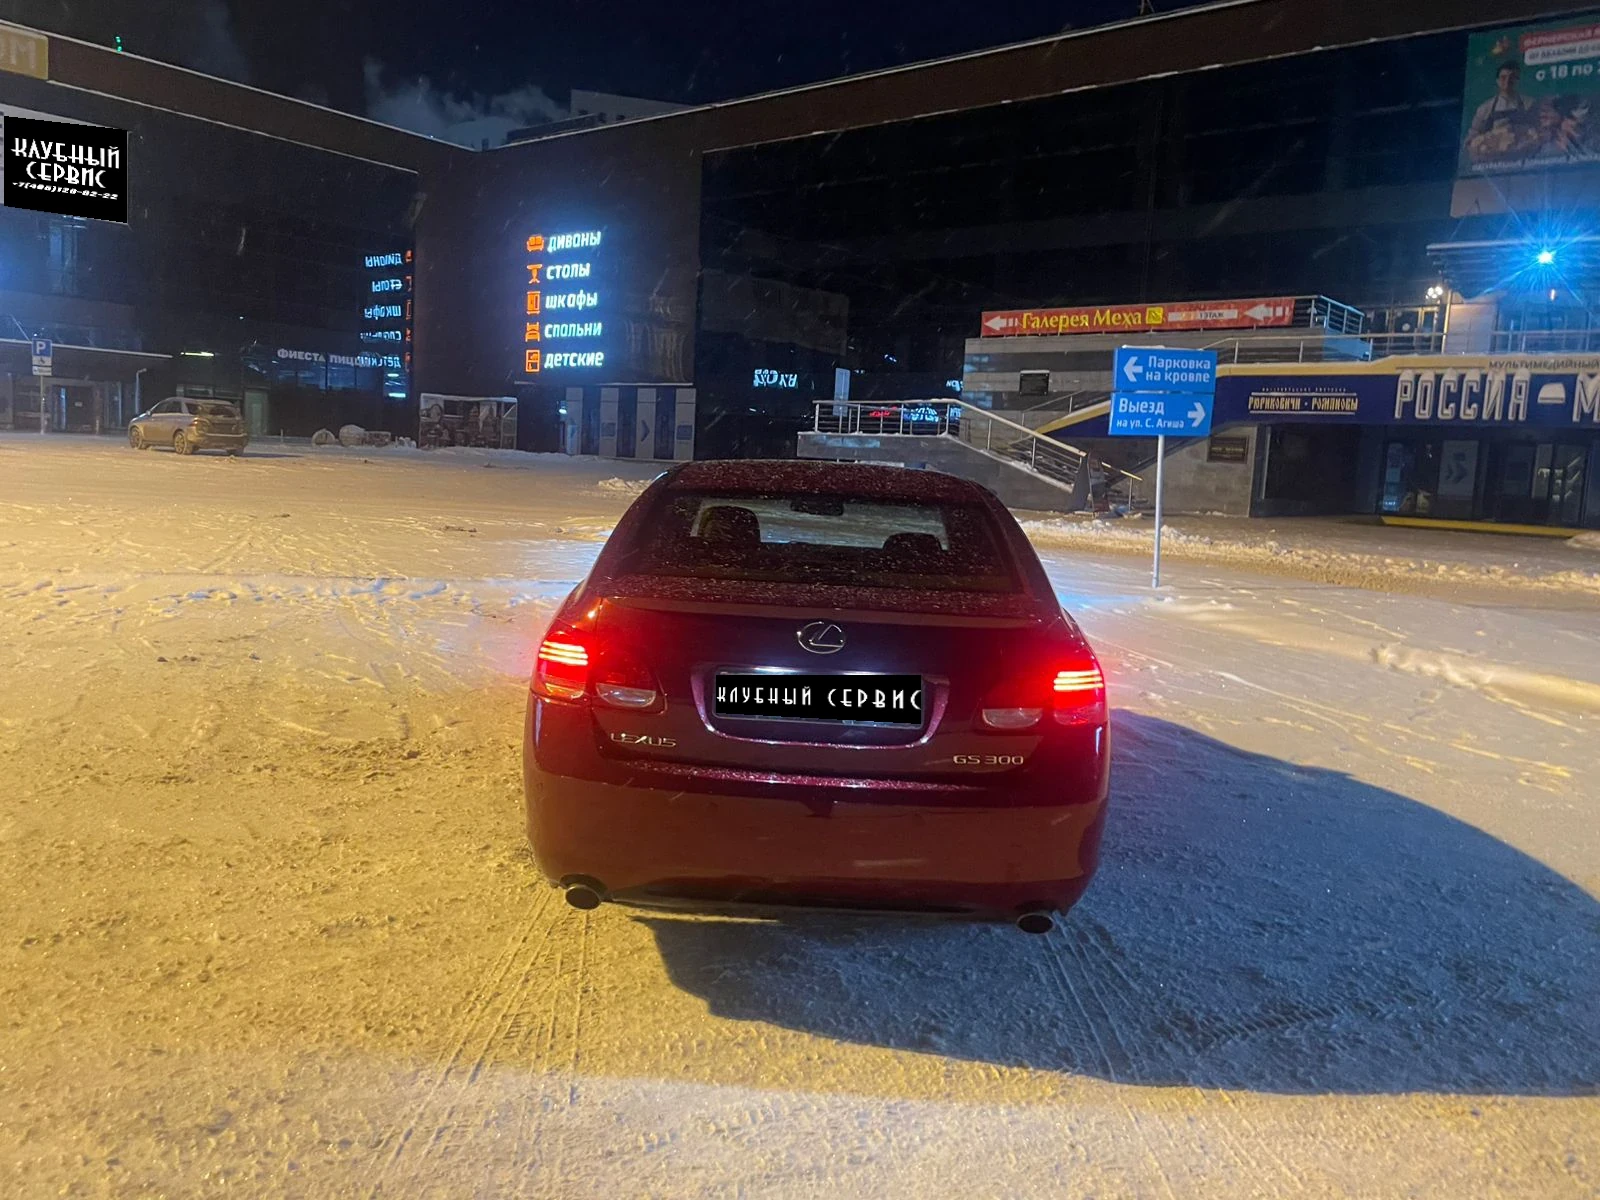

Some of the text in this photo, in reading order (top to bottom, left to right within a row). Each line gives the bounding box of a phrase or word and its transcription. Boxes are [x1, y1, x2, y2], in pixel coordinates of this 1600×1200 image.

[546, 262, 591, 280] столы
[1022, 308, 1142, 334] Галерея Меха
[36, 341, 46, 355] P
[277, 348, 326, 361] ФИЕСТА
[544, 351, 605, 369] детские
[1148, 355, 1211, 372] Парковка
[1145, 371, 1211, 384] на кровле
[1395, 368, 1531, 421] РОССИЯ
[1119, 398, 1165, 416] Выезд
[1116, 418, 1185, 430] на ул. С. Агиша
[610, 732, 677, 748] LEXUS
[953, 754, 1025, 765] GS 300
